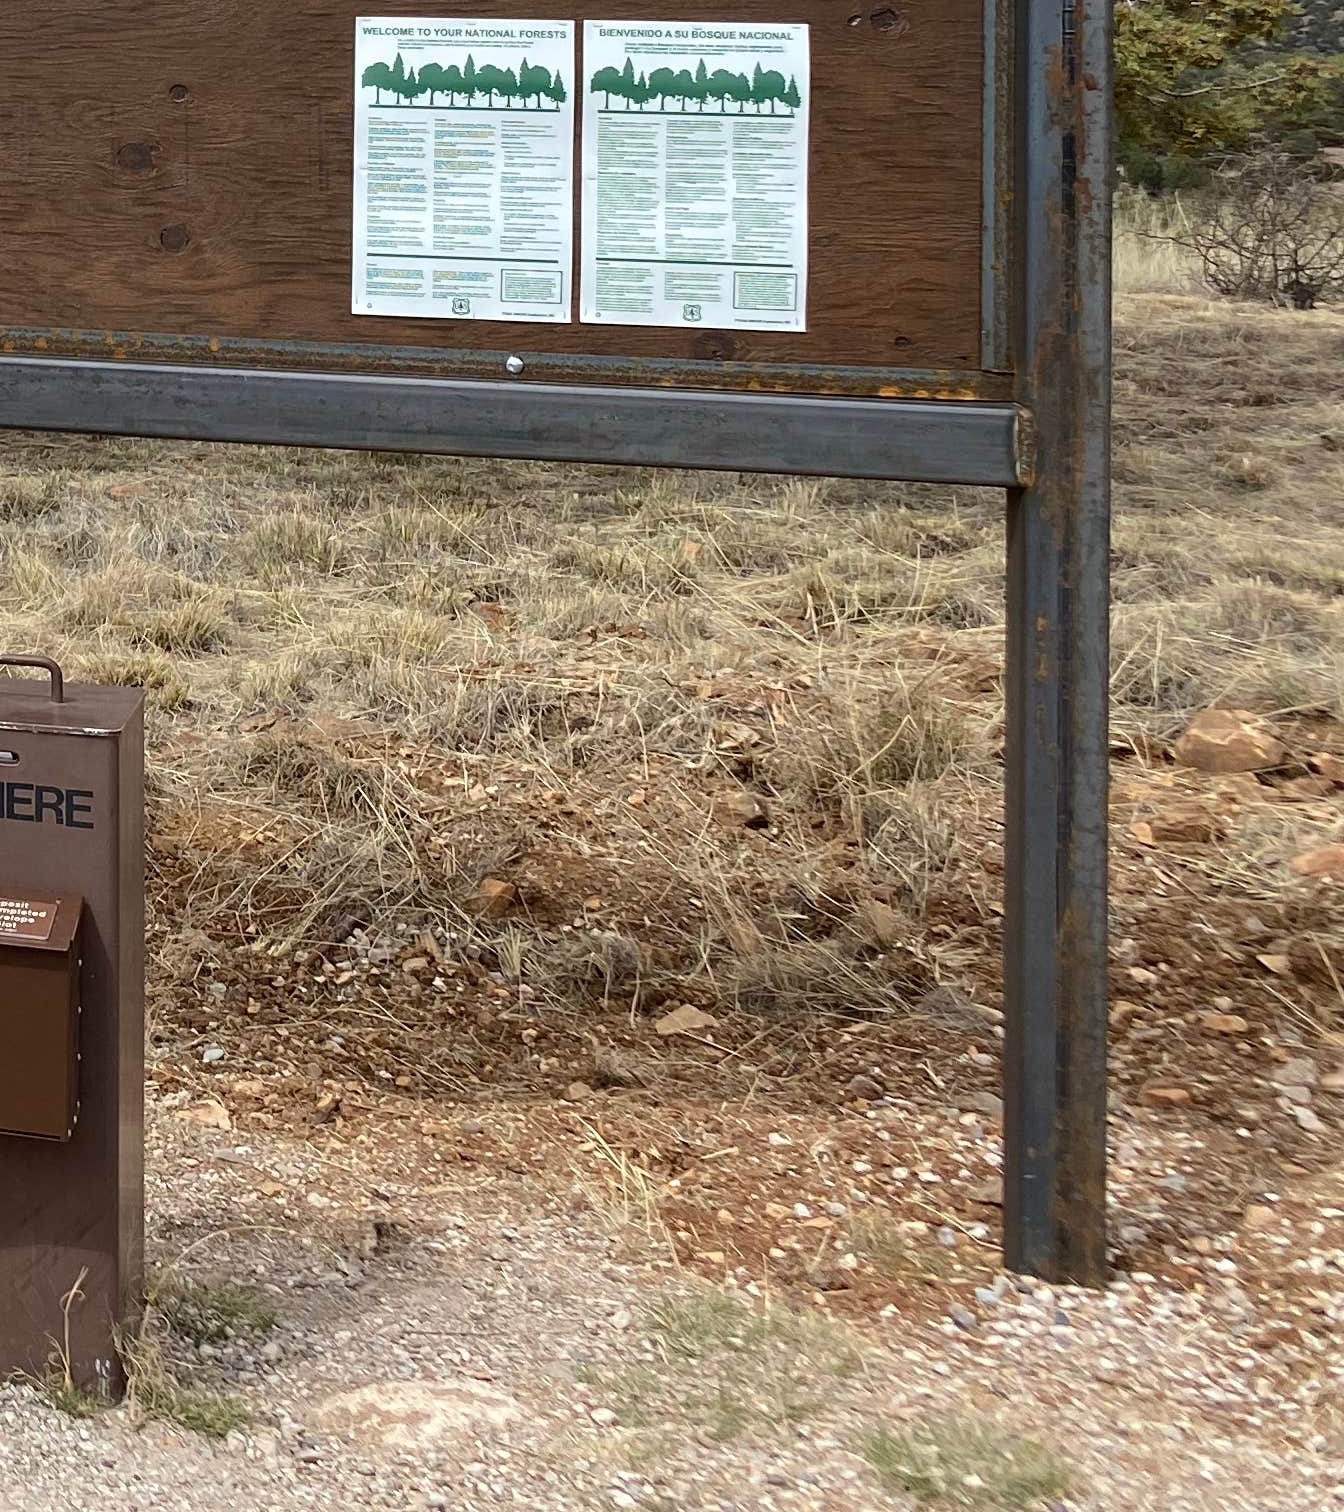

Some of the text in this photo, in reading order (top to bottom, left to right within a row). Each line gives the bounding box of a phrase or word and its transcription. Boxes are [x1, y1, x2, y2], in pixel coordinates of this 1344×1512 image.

[362, 27, 567, 39] WELCOME TO YOUR NATIONAL FORESTS
[599, 28, 793, 40] BIENVENIDO A SU BOSQUE NACIONAL
